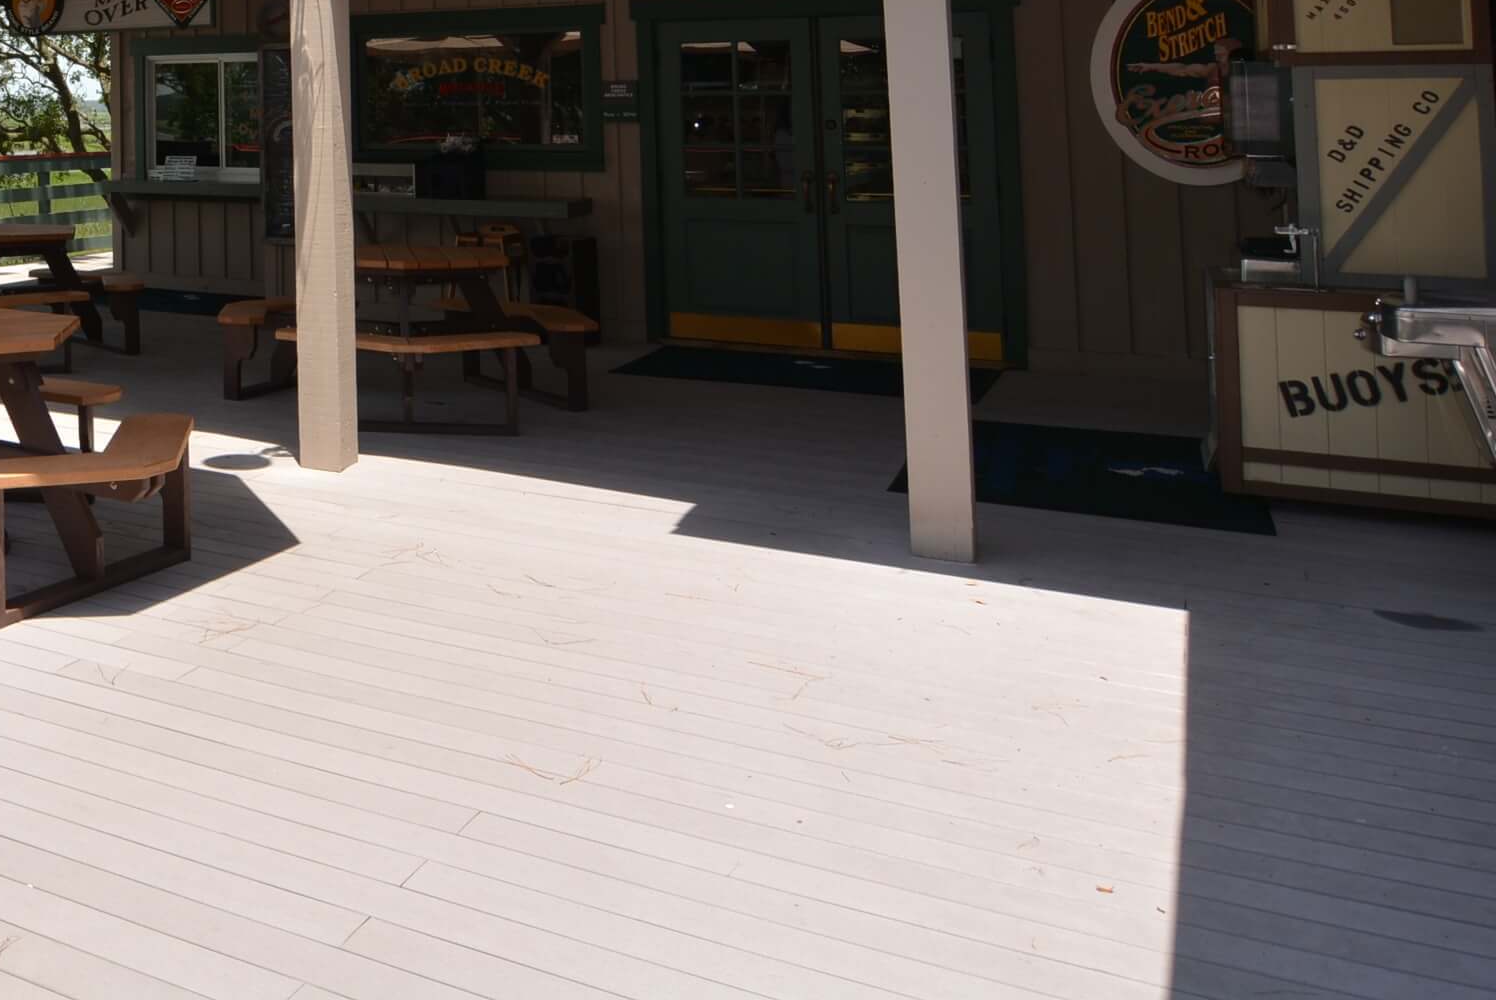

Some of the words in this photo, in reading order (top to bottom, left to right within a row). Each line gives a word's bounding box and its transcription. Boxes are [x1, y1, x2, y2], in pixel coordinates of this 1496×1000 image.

[1145, 4, 1187, 39] BEND
[1159, 12, 1229, 64] STRETCH
[1327, 124, 1364, 163] D&D
[1335, 123, 1412, 213] SHIPPING
[1412, 90, 1440, 115] CO
[1278, 358, 1449, 418] BUOYS
